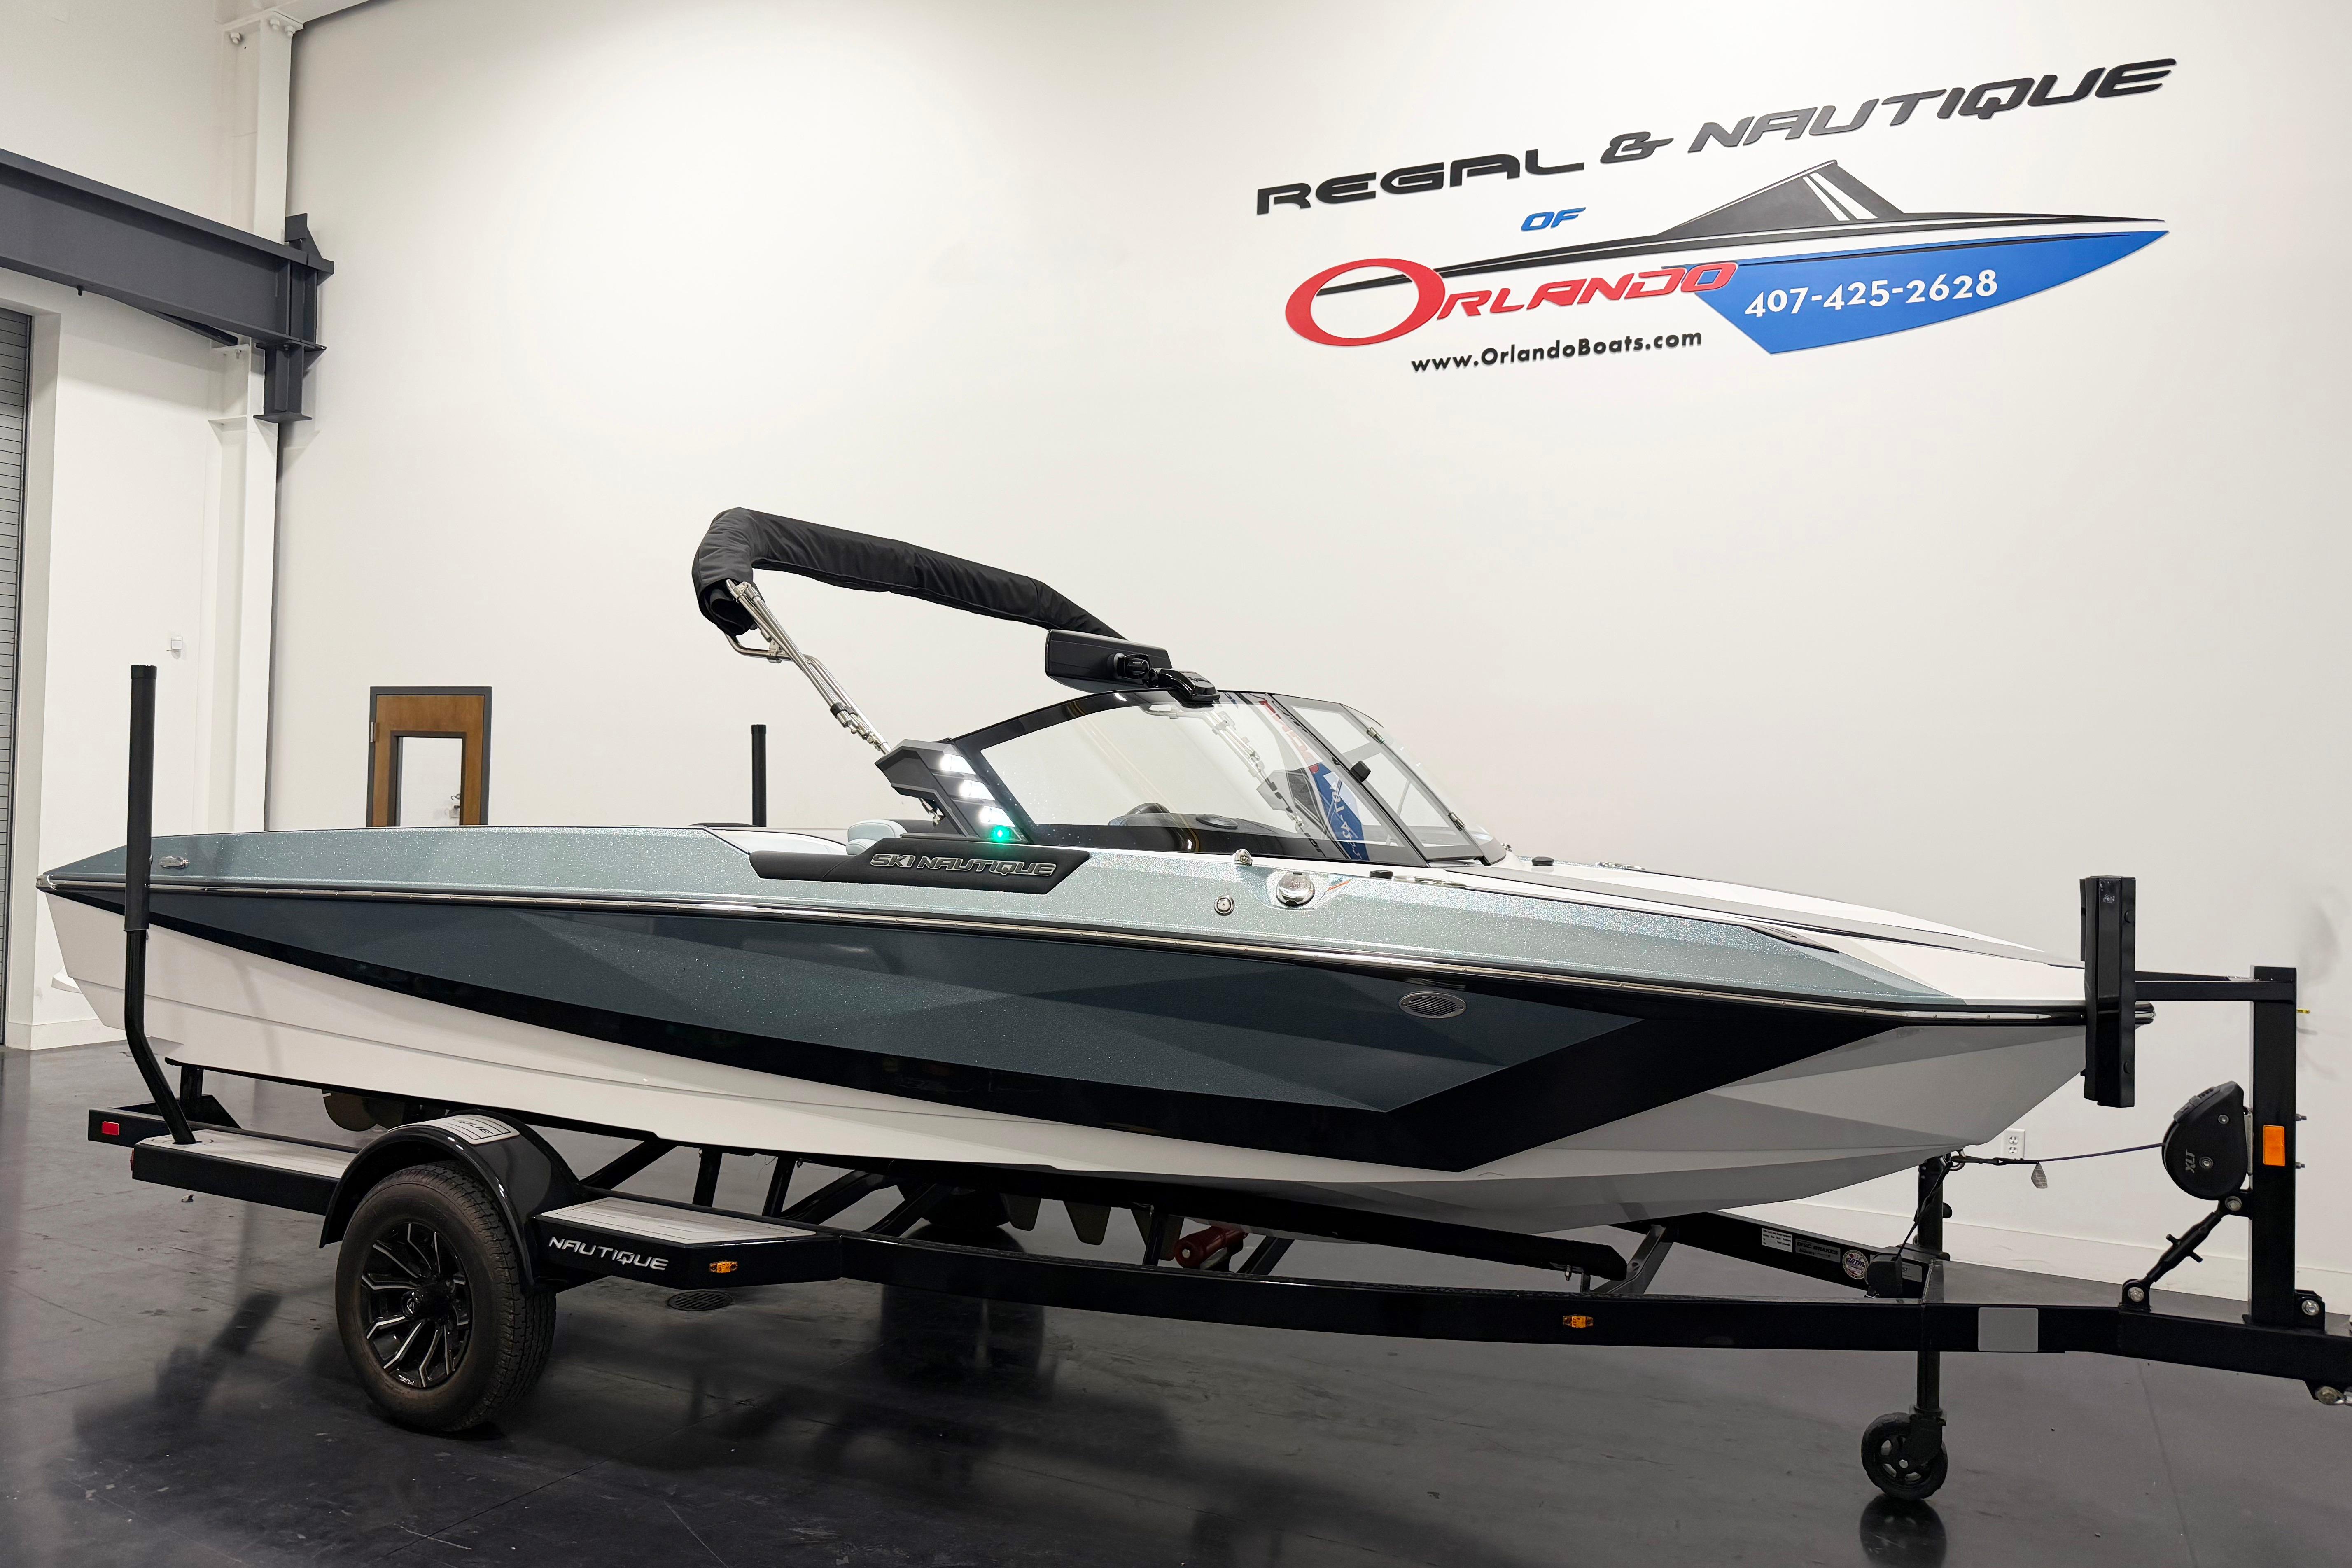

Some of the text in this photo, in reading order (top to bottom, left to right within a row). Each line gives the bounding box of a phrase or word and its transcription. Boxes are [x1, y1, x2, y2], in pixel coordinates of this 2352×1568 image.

[1257, 58, 2177, 215] REGAL & NAUTIQUE
[1521, 208, 1586, 231] OF
[1285, 258, 1737, 347] ORLANDO
[1745, 269, 1997, 317] 407-425-2628
[1411, 332, 1701, 372] www.OrlandoBoats.com
[870, 854, 1057, 876] SKI NAUTIQUE
[548, 1237, 669, 1271] NAUTIQUE
[1813, 1245, 1838, 1255] BRAKES
